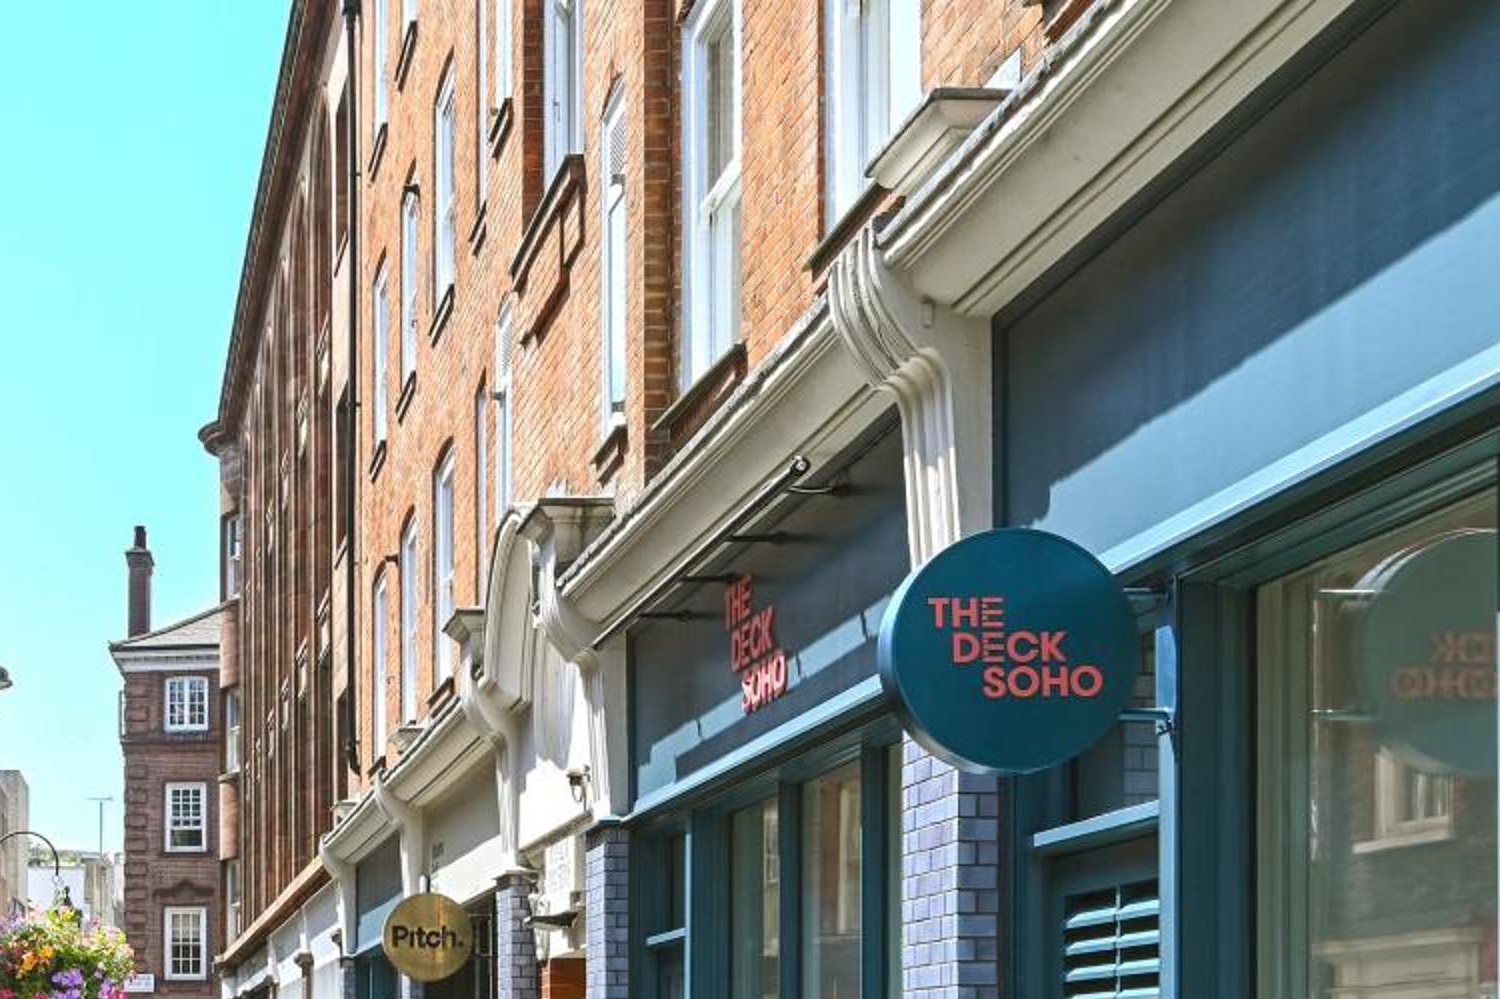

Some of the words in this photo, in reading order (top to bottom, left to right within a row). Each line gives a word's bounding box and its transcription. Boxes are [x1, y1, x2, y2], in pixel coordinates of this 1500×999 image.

[725, 574, 752, 631] THE
[928, 598, 1004, 627] THE
[731, 606, 773, 672] DECK
[953, 631, 1067, 662] DECK
[741, 650, 787, 713] SOHO
[982, 665, 1104, 698] SOHO
[392, 925, 463, 949] Pitch.
